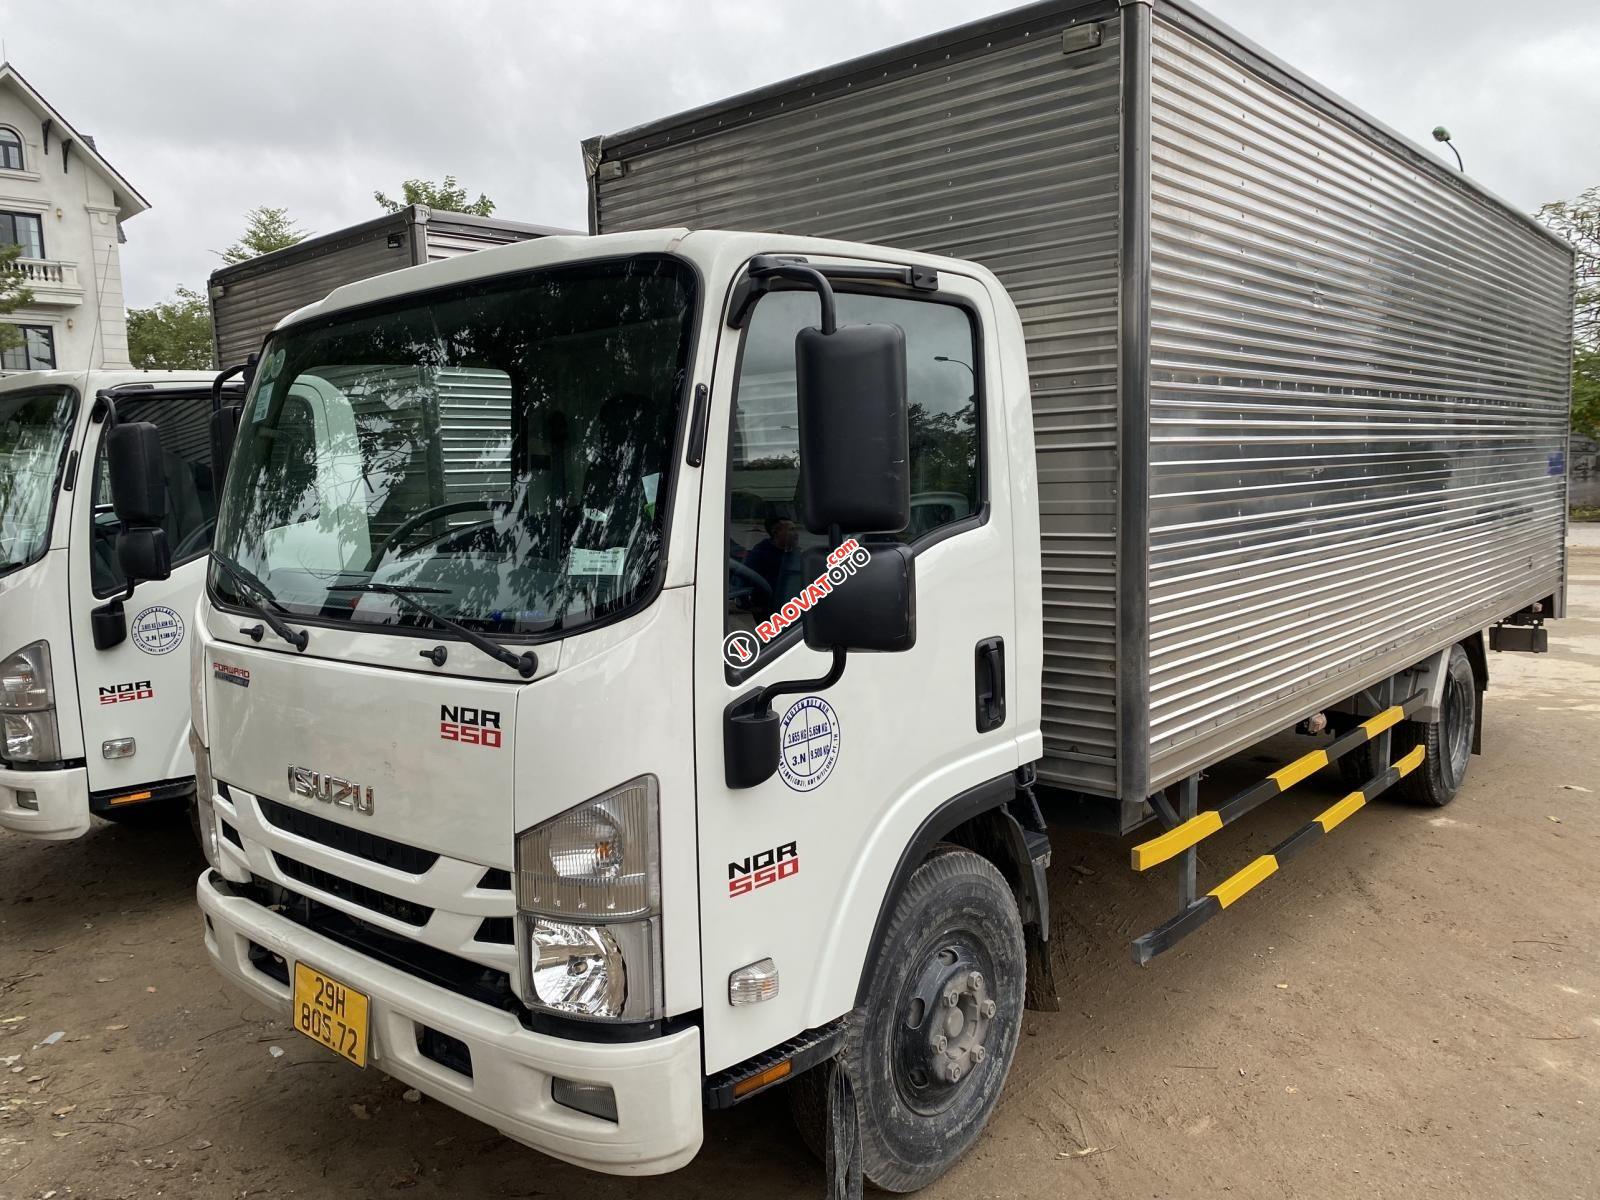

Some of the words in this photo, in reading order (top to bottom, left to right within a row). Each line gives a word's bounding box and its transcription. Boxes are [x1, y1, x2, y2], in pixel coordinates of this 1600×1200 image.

[213, 662, 250, 678] FORWARD
[98, 680, 153, 695] NQR
[99, 690, 154, 705] 550
[440, 704, 501, 729] NQR
[440, 722, 502, 748] 550
[791, 753, 807, 766] 3.N
[287, 762, 375, 817] ISUZU
[728, 841, 798, 879] NQR
[729, 858, 799, 898] 550
[314, 976, 346, 1018] 29H
[301, 1003, 357, 1060] 805.72
